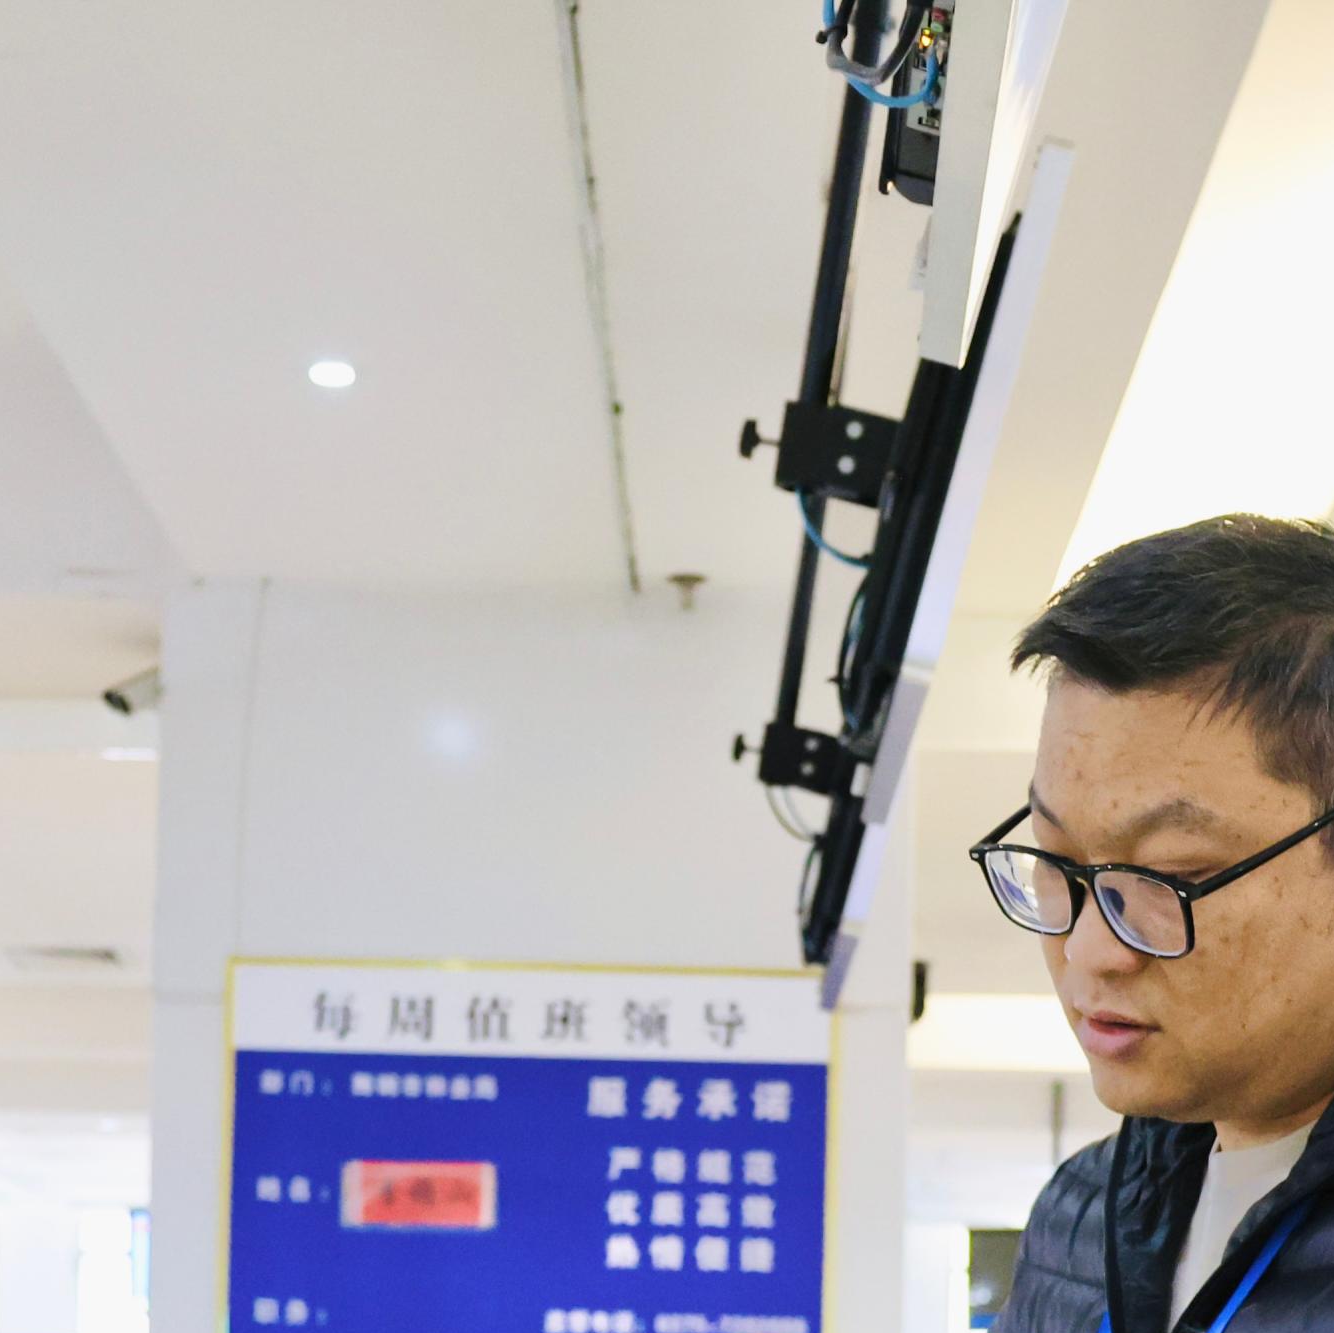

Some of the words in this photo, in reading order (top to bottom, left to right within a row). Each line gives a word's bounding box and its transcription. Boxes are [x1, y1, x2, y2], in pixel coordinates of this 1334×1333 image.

[312, 991, 746, 1047] 每周值班领导
